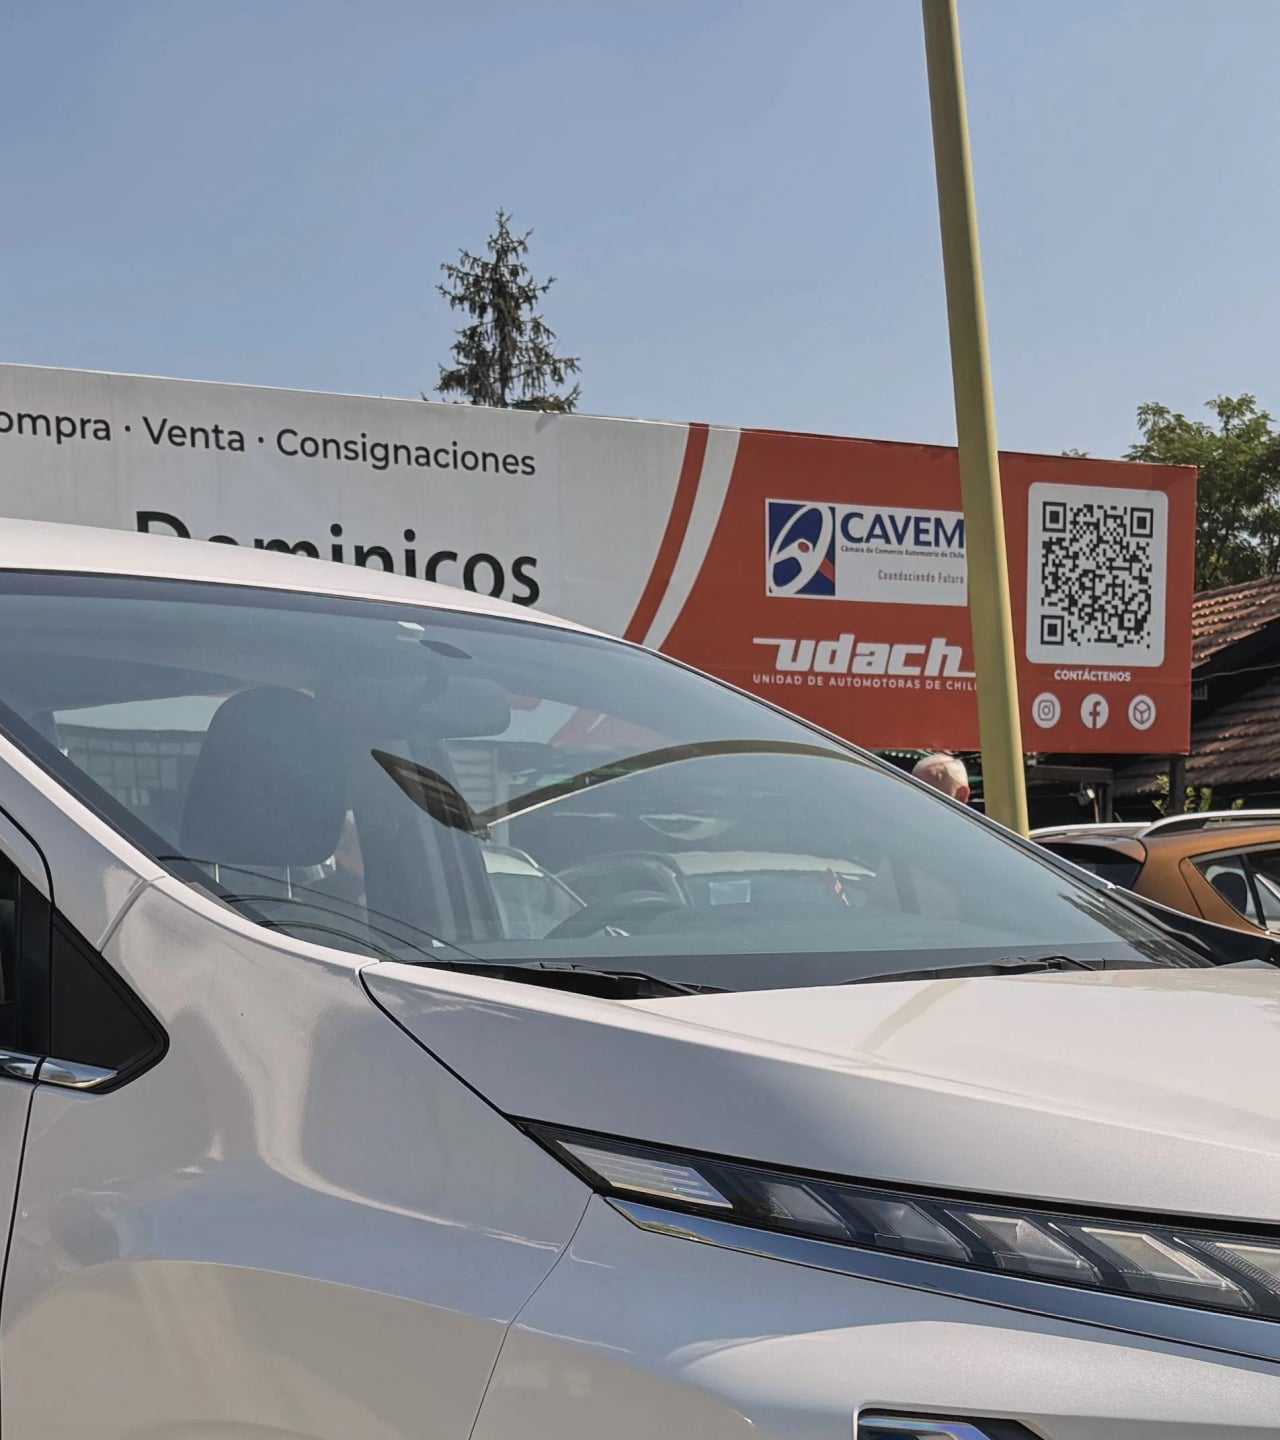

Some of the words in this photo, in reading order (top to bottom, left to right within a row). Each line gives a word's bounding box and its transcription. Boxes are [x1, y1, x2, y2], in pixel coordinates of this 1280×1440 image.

[142, 416, 245, 452] Venta
[276, 428, 536, 476] Consignaciones
[840, 511, 965, 549] CAVEM
[752, 674, 802, 685] UNIDAD
[807, 676, 824, 686] DE
[829, 677, 921, 689] AUTOMOTORAS
[925, 680, 941, 690] DE
[946, 681, 978, 691] CHIL
[1054, 668, 1131, 682] CONTÁCTENOS
